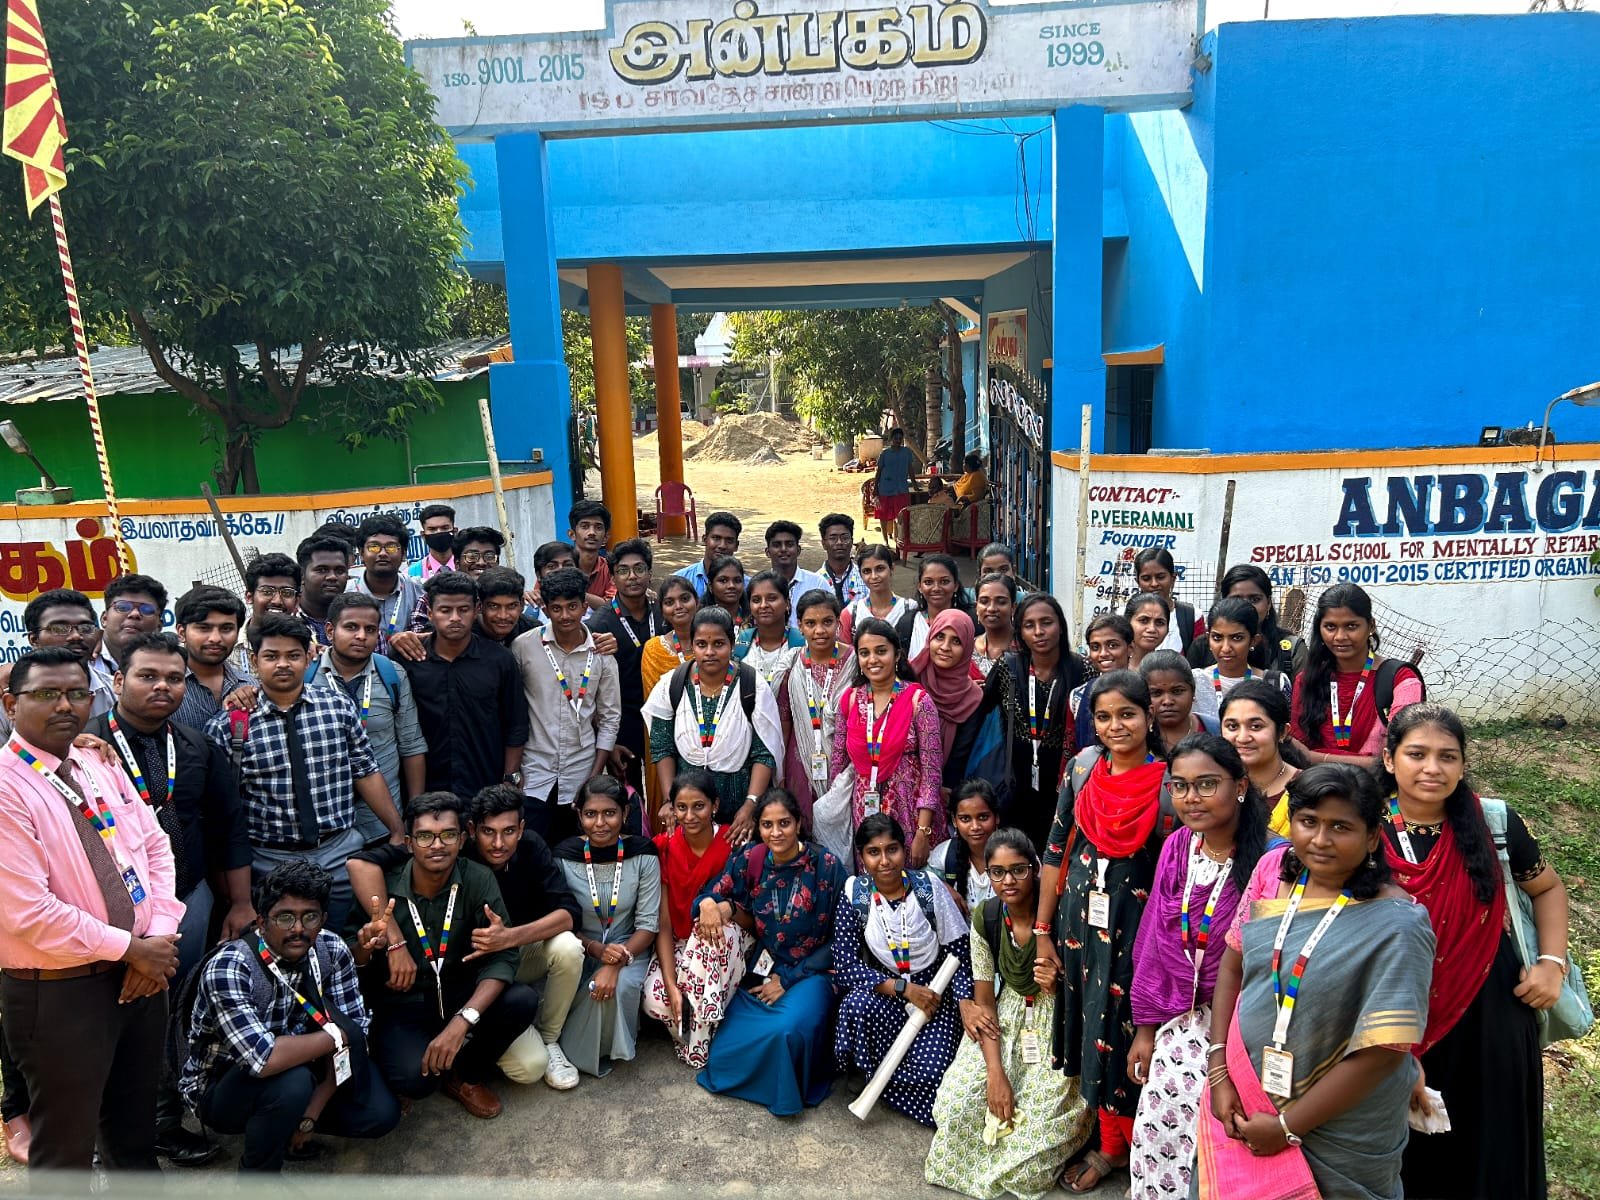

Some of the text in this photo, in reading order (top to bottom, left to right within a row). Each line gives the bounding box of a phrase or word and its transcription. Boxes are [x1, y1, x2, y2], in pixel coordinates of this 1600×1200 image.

[608, 0, 987, 86] அன்பகம்
[1039, 23, 1100, 39] SINCE
[1047, 41, 1104, 67] 1999
[1100, 530, 1176, 549] FOUNDER
[1250, 544, 1325, 563] SPECIAL
[1328, 541, 1391, 562] SCHOOL
[1400, 541, 1424, 559] FOR
[1432, 536, 1539, 559] MENTALLY
[1270, 567, 1295, 585] AN
[1302, 565, 1332, 585] ISO
[1338, 563, 1429, 583] 9001-2015
[1434, 559, 1530, 581] CERTIFIED
